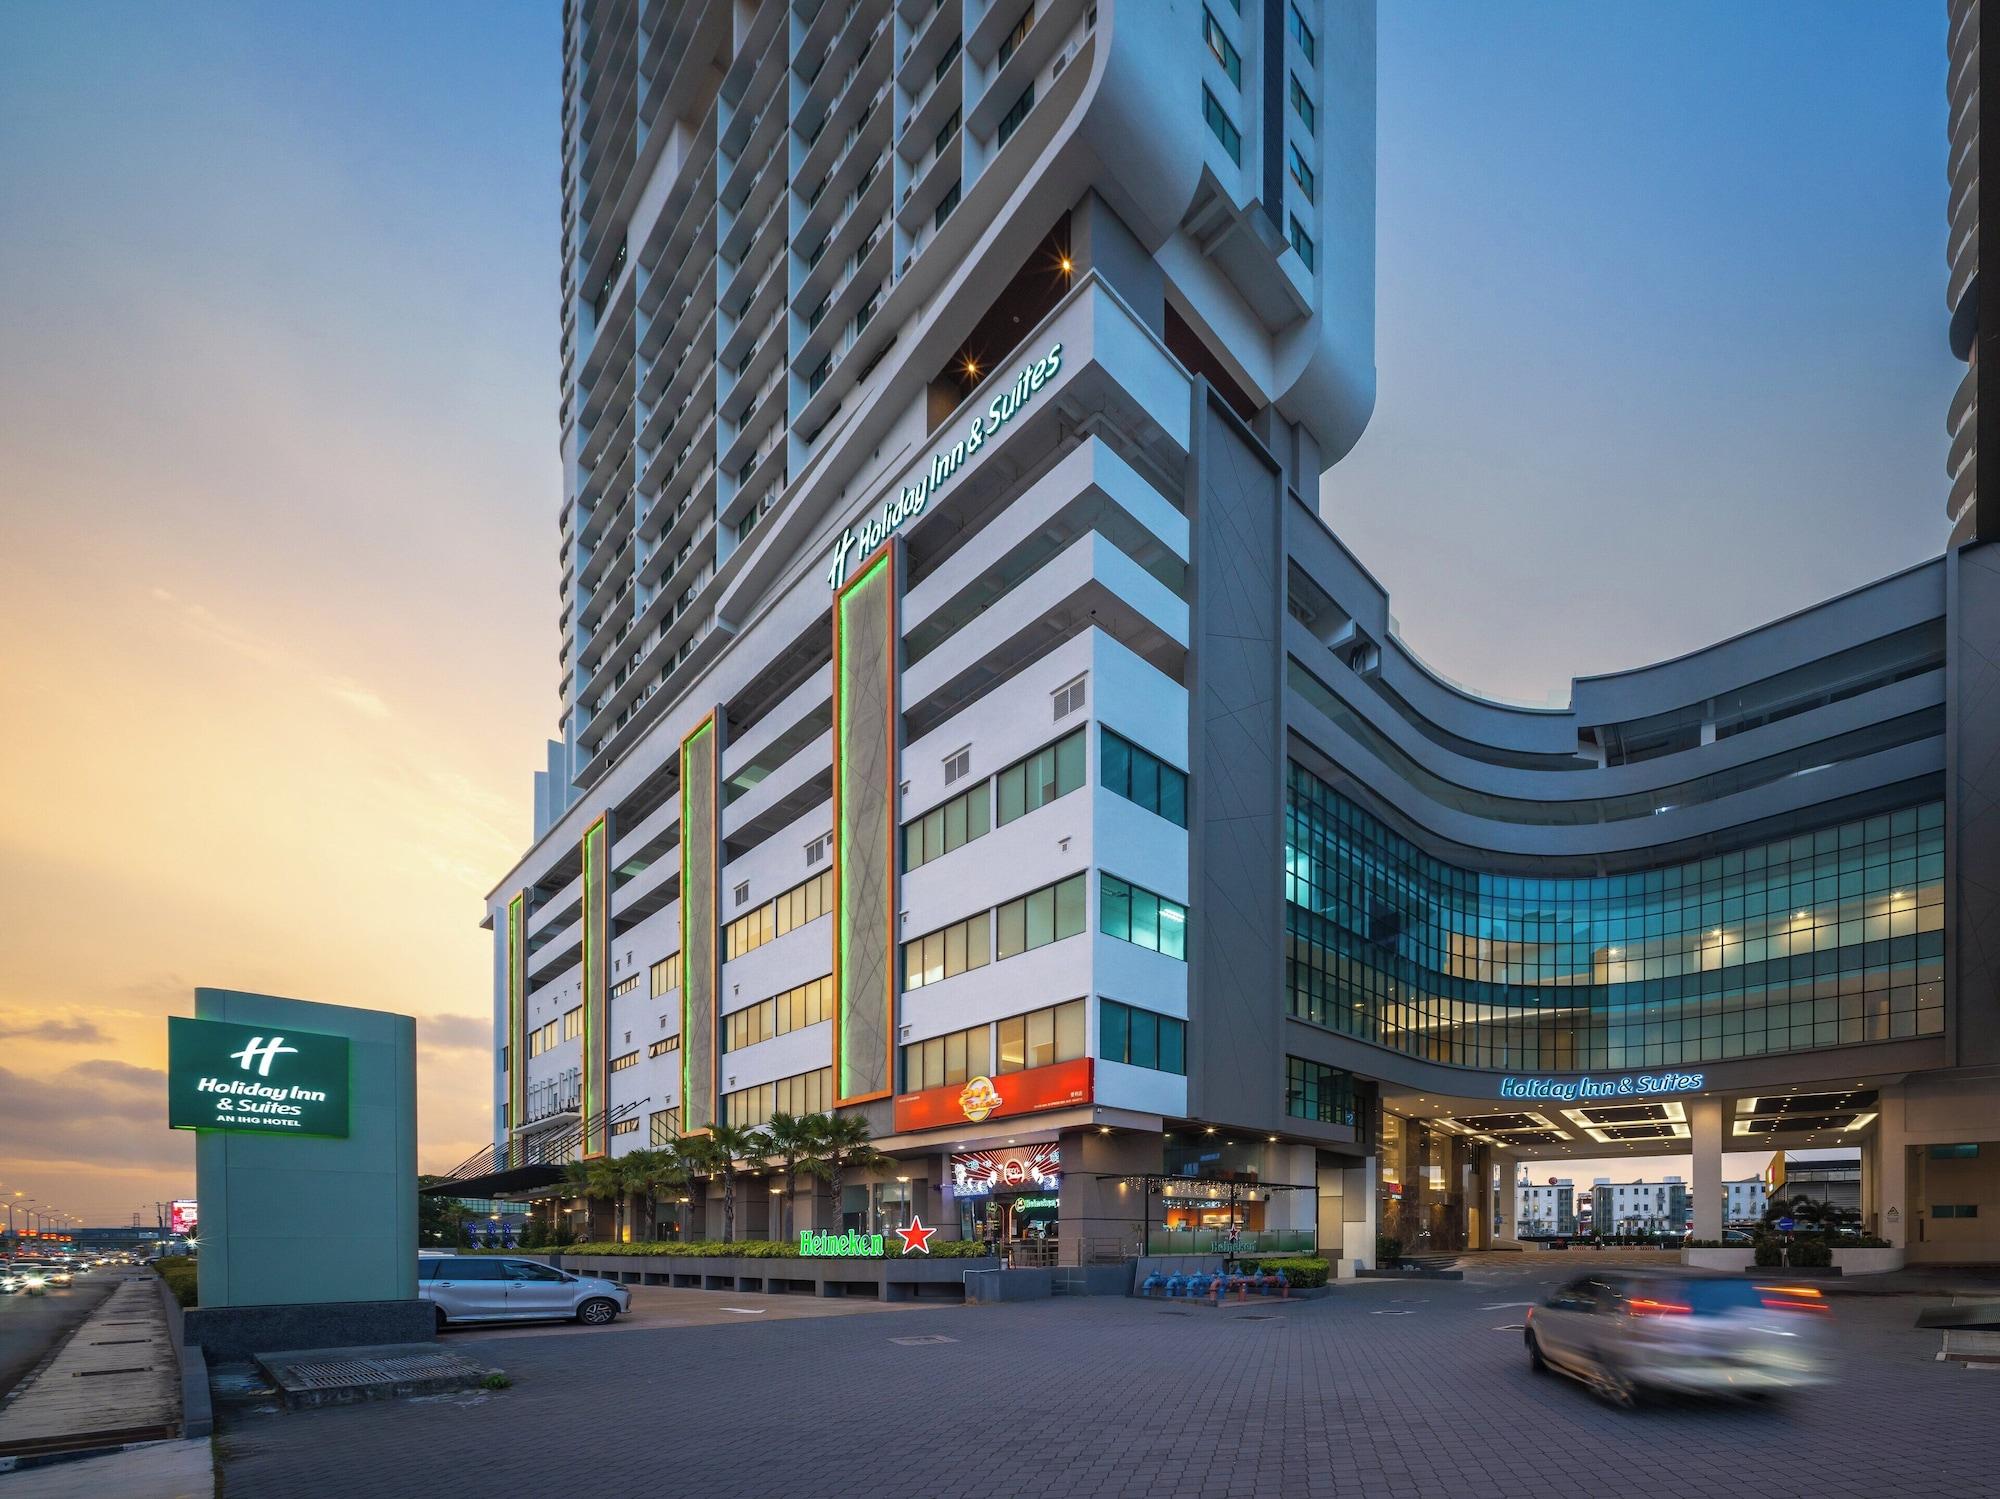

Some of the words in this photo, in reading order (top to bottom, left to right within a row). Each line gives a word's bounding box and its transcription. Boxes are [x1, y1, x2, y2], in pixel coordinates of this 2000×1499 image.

[858, 475, 929, 560] Holiday
[930, 440, 966, 493] Inn
[967, 417, 985, 454] &
[986, 342, 1063, 437] Suites
[197, 1078, 288, 1101] Holiday
[289, 1085, 326, 1102] Inn
[1501, 1077, 1578, 1101] Holiday
[1580, 1077, 1615, 1097] Inn
[1618, 1077, 1633, 1094] &
[1636, 1073, 1704, 1093] Suites
[216, 1097, 234, 1111] &
[237, 1099, 302, 1116] Suites
[238, 1116, 260, 1124] IHG
[263, 1117, 301, 1127] HOTEL
[800, 1228, 884, 1257] Heineken
[1210, 1240, 1257, 1253] Heineken
